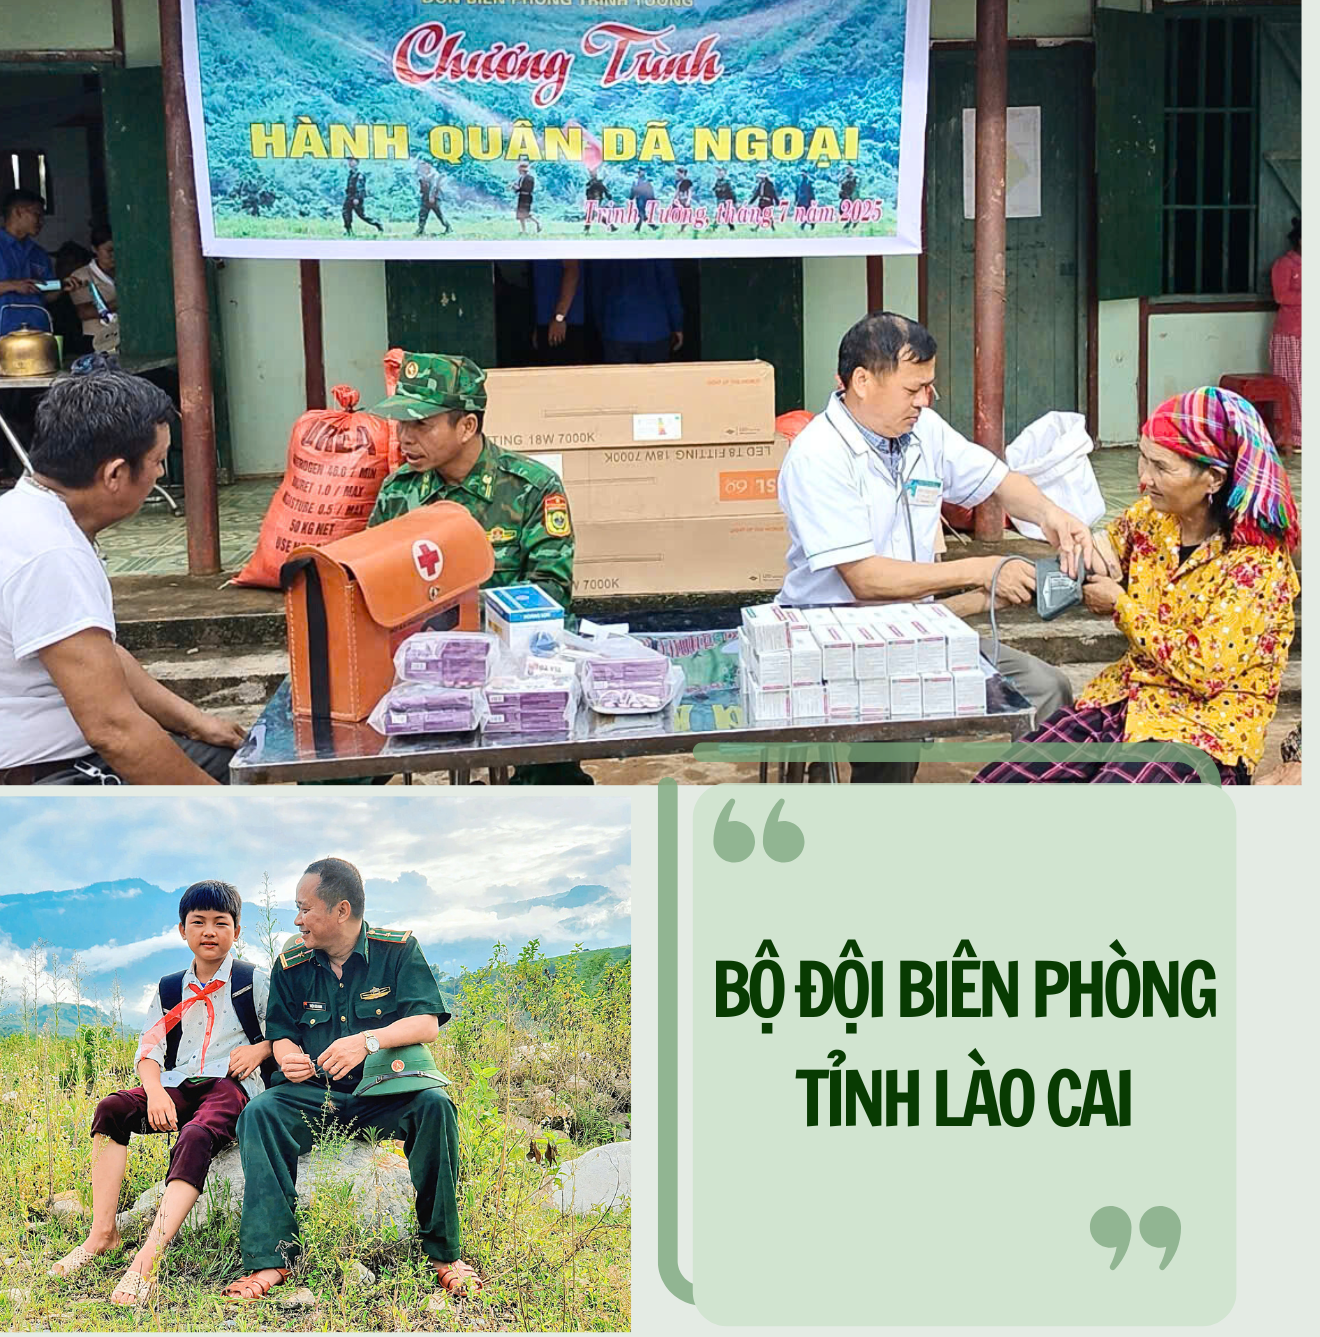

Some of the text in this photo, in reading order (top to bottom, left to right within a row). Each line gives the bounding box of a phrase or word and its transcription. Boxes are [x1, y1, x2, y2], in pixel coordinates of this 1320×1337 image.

[394, 21, 724, 108] Chương Trình
[250, 116, 860, 168] HÀNH QUÂN DÃ NGOẠI
[715, 198, 775, 229] tháng
[778, 199, 791, 224] 7
[793, 199, 836, 224] năm
[838, 199, 883, 224] 2025
[300, 418, 377, 456] UREA
[486, 432, 596, 446] TING 18W 7000K
[604, 445, 772, 463] LED T8 FITTING 18W 7000K
[343, 485, 365, 498] MAX
[754, 478, 776, 494] SL
[289, 519, 336, 536] 50 KG NET
[275, 536, 293, 553] USE
[583, 578, 620, 591] 7000K
